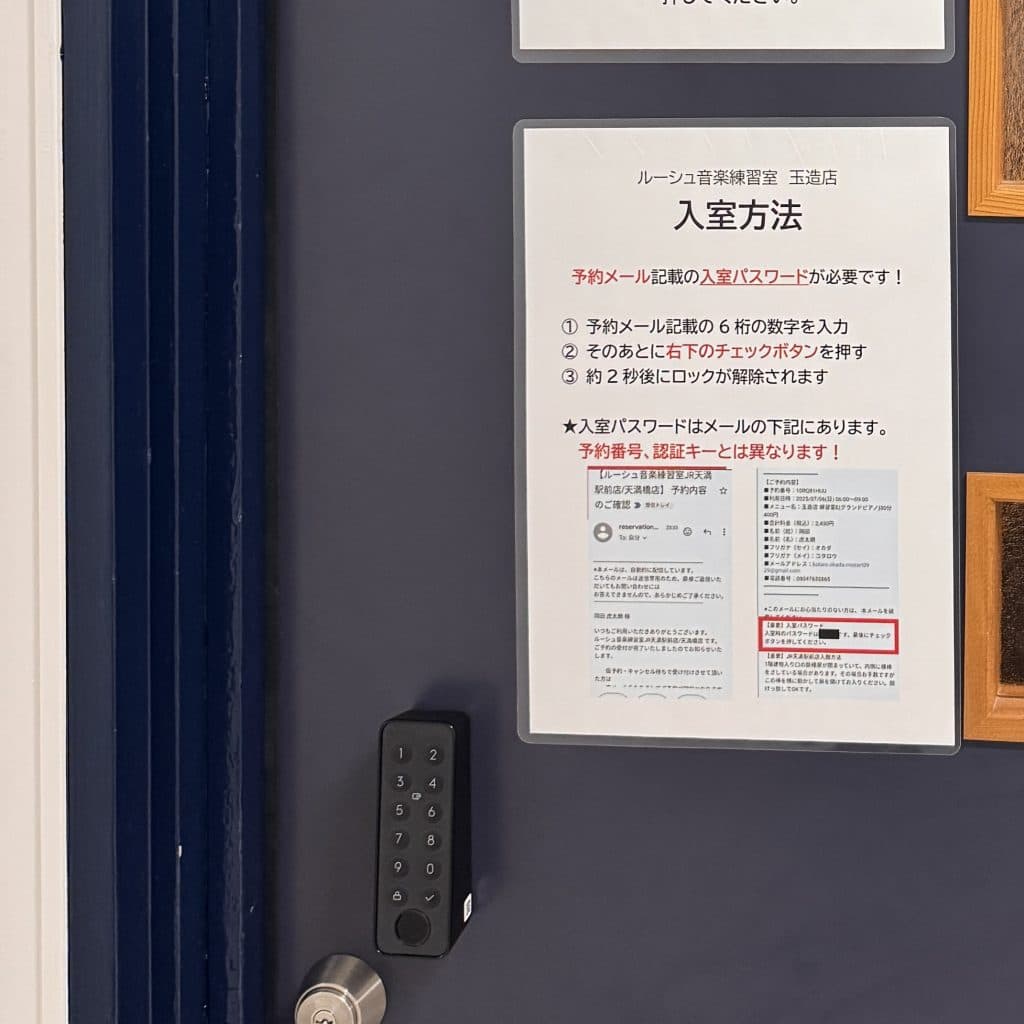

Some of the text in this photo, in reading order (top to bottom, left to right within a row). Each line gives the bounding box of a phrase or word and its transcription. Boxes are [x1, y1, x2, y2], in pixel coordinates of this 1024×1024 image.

[637, 169, 838, 186] ルーシュ音楽練習室 玉造店
[673, 198, 803, 231] 入室方法
[399, 748, 404, 759] 1
[430, 750, 438, 761] 2
[397, 776, 404, 787] 3
[429, 778, 437, 789] 4
[396, 804, 403, 816] 5
[428, 807, 436, 818] 6
[395, 833, 402, 844] 7
[427, 835, 435, 846] 8
[394, 861, 402, 873] 9
[426, 863, 434, 875] 0
